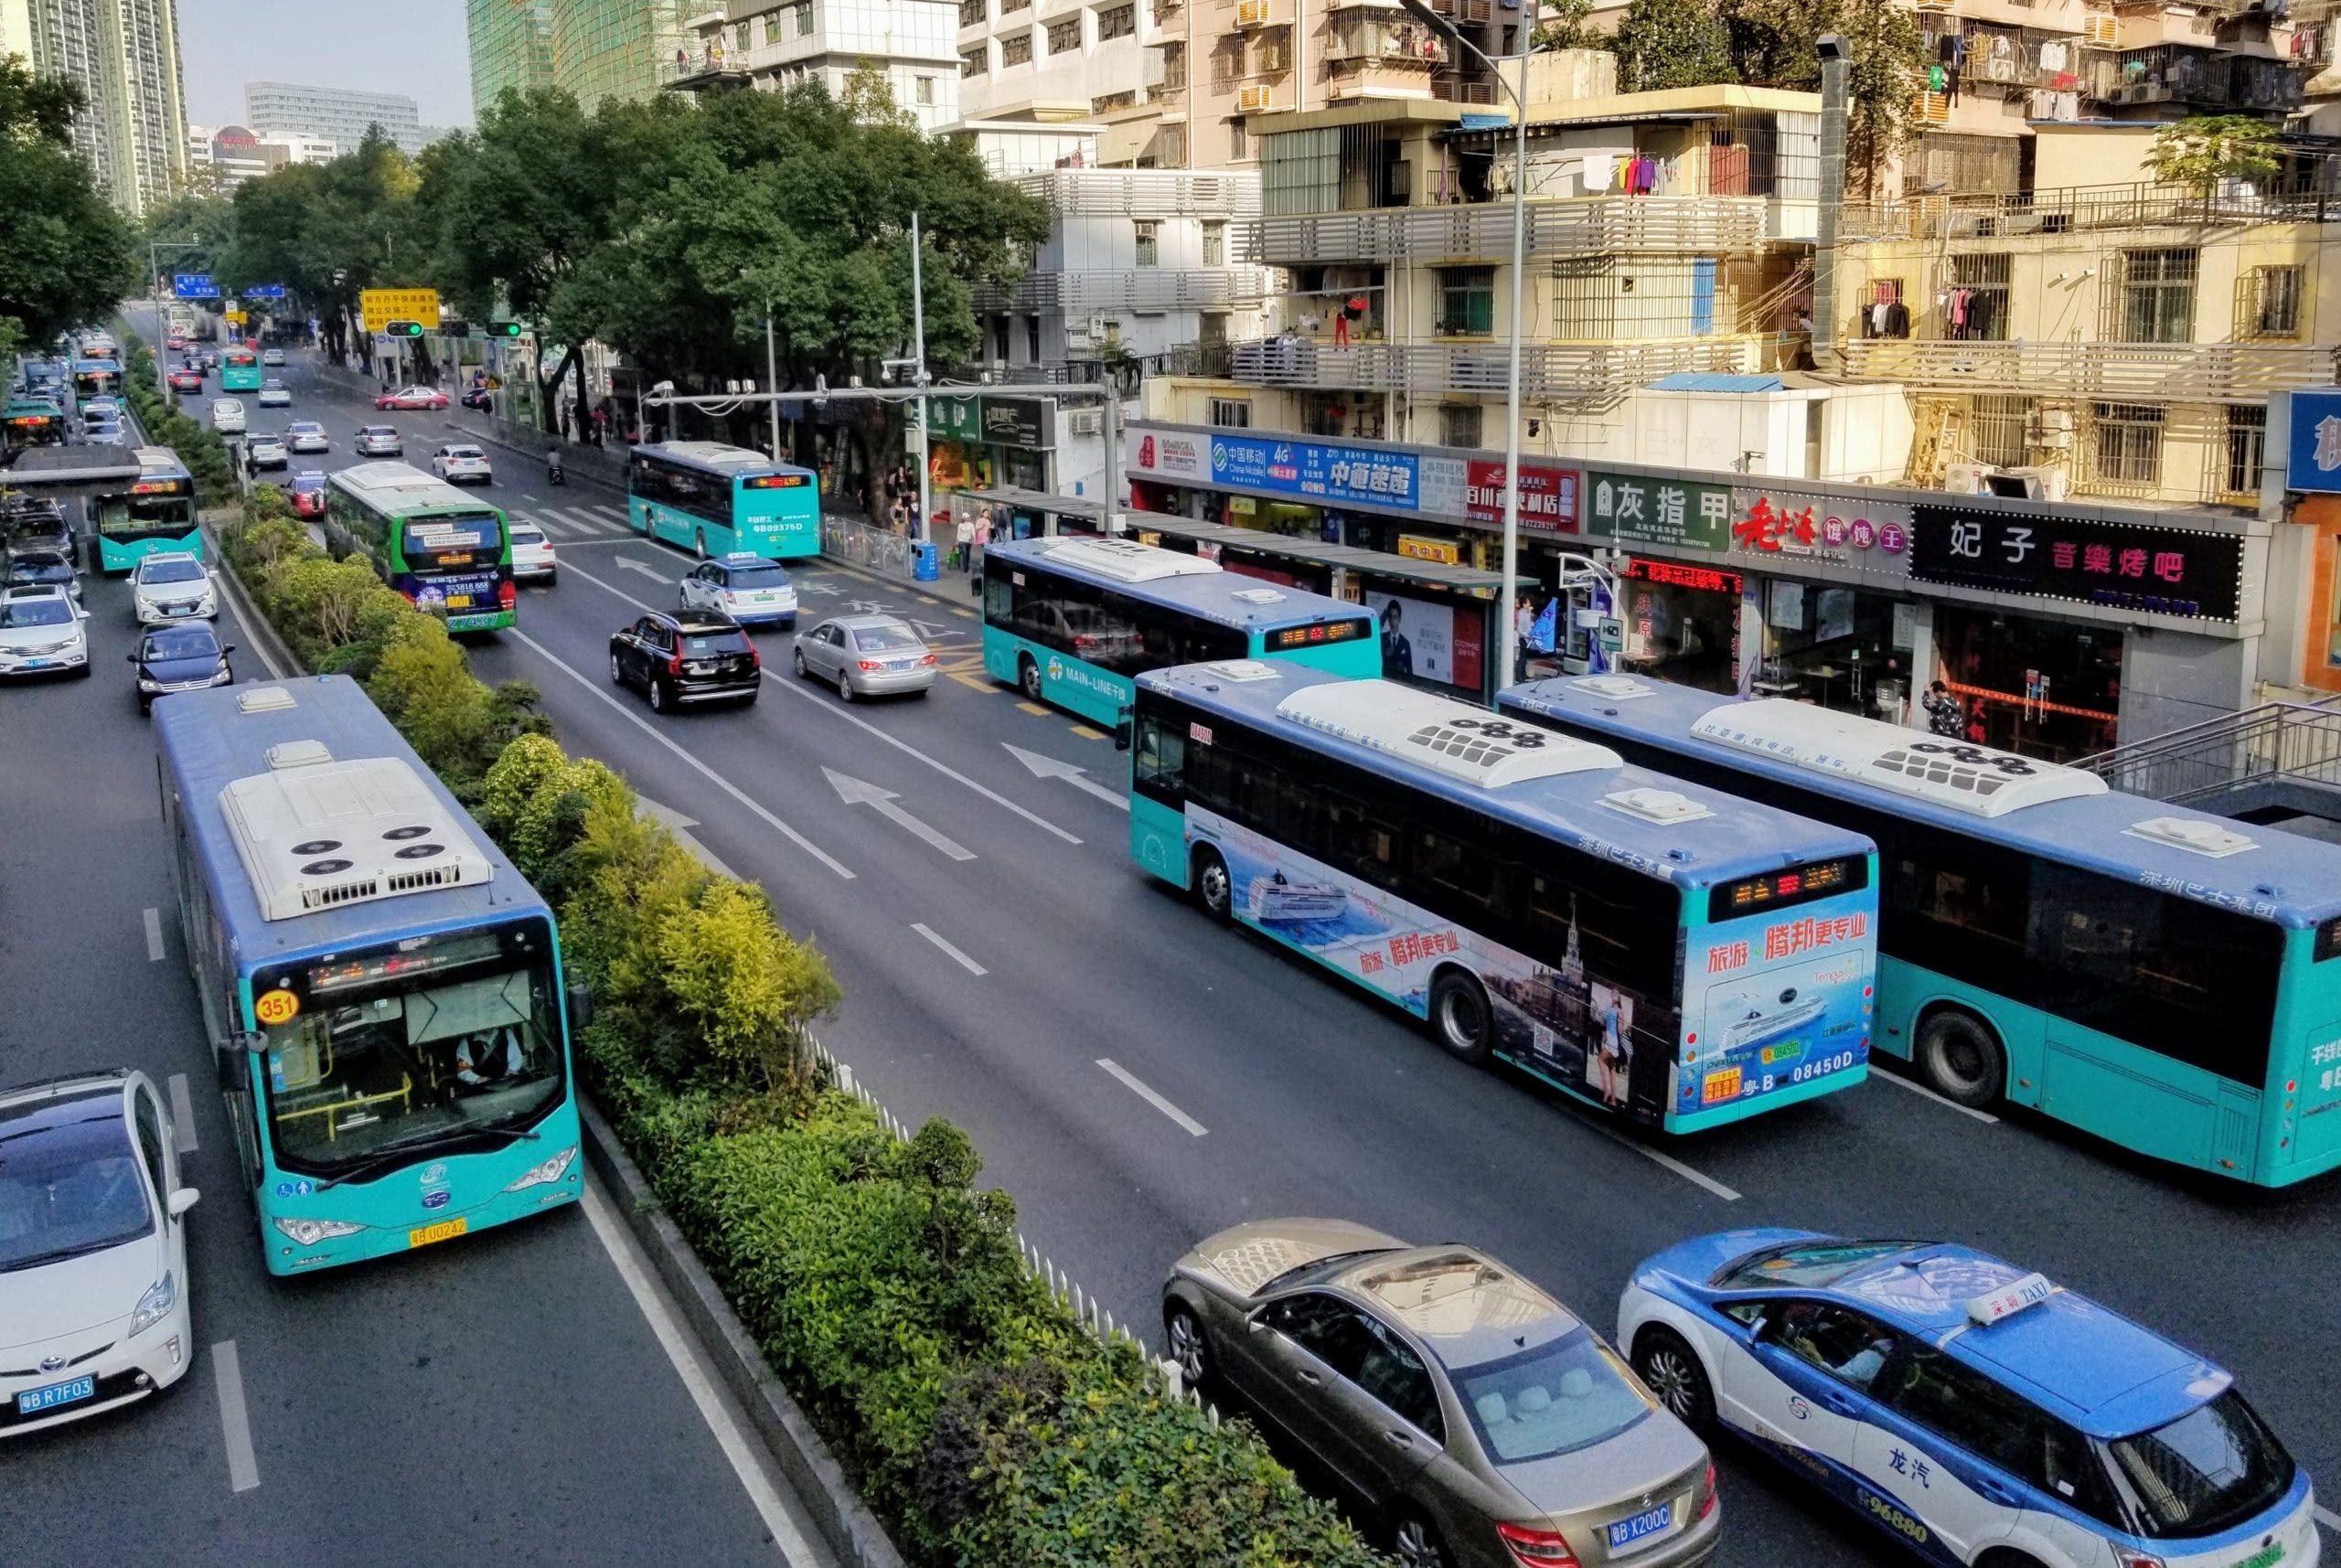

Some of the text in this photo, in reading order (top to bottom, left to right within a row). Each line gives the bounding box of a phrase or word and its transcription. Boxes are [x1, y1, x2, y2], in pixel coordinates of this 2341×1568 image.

[1228, 446, 1264, 464] 中国移动
[1229, 464, 1245, 474] China
[1245, 464, 1264, 476] Mobile
[1617, 483, 1728, 529] 灰指甲
[1733, 496, 1817, 550] 老上海
[1950, 520, 2036, 563] 妃子
[2052, 541, 2186, 583] 音樂烤吧
[2140, 870, 2277, 919] 深圳巴士集团
[1359, 928, 1460, 976] 旅游 腾邦更专业
[1708, 912, 1867, 975] 旅游 腾邦更专业
[262, 996, 294, 1019] 351
[1793, 1051, 1853, 1083] 08450D
[2019, 1281, 2048, 1303] TAXI
[1889, 1447, 1930, 1489] 龙汽
[1869, 1496, 1928, 1543] 96880
